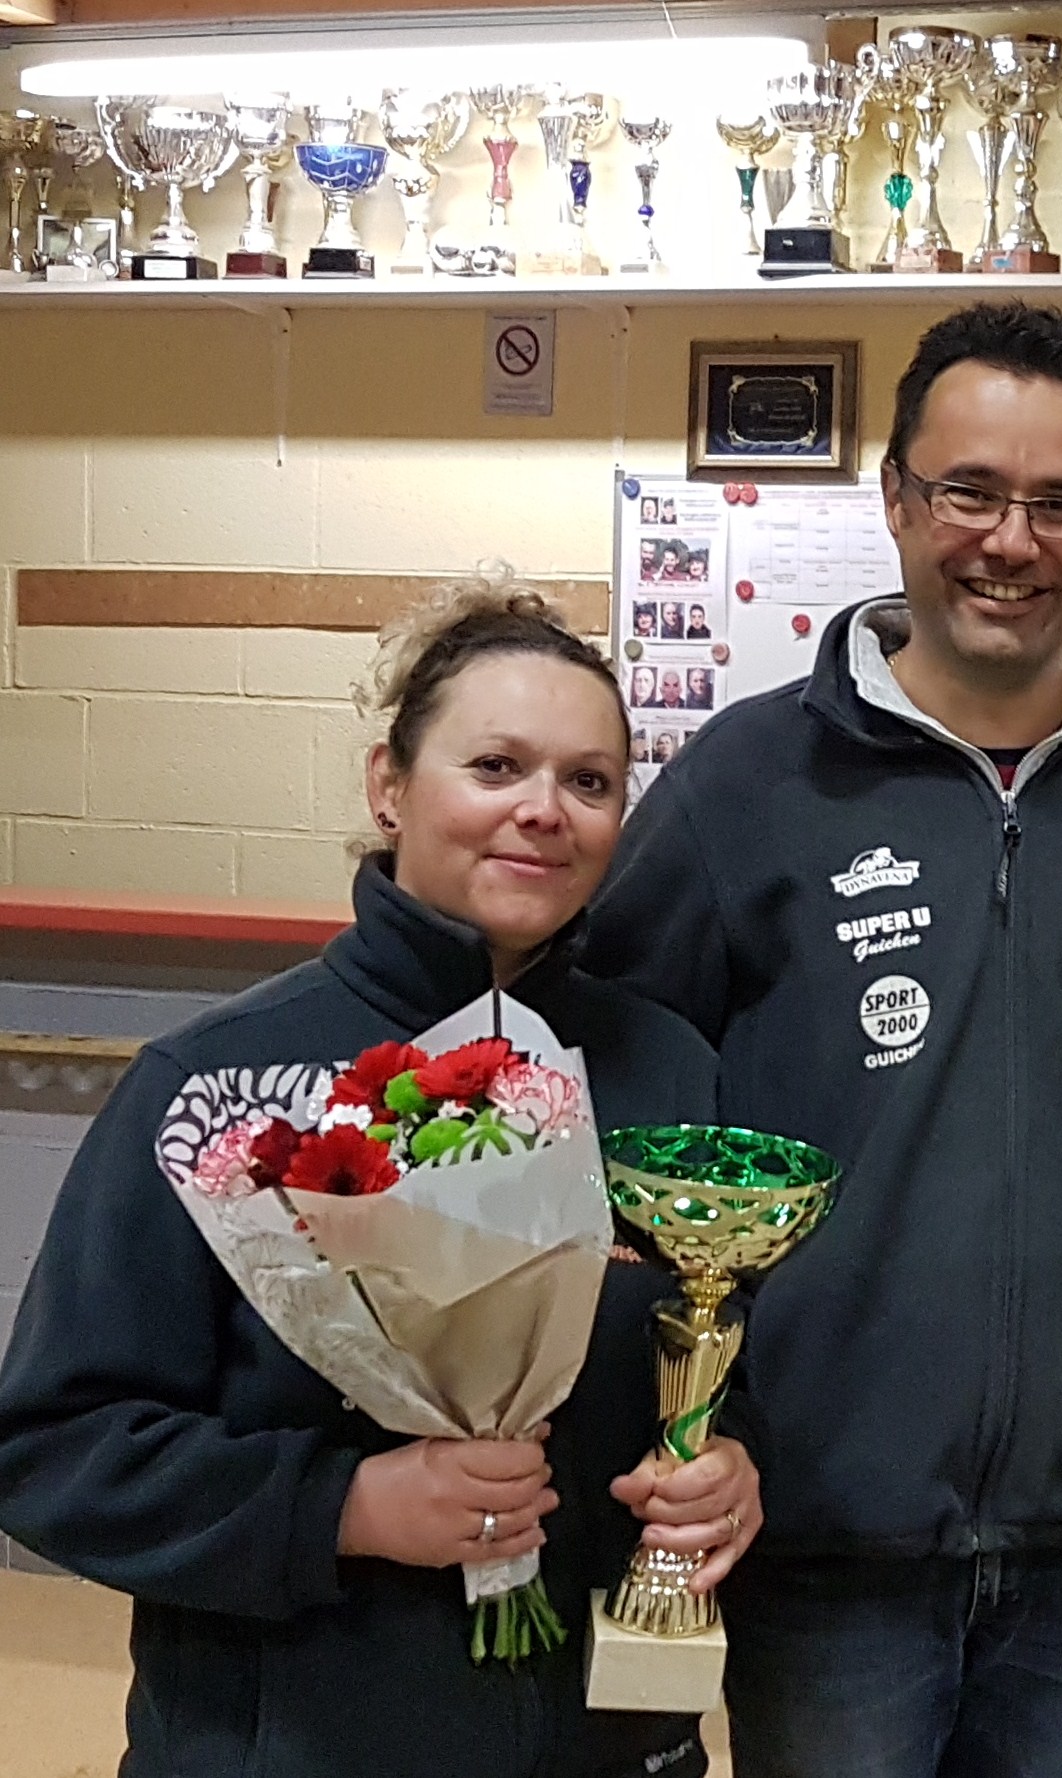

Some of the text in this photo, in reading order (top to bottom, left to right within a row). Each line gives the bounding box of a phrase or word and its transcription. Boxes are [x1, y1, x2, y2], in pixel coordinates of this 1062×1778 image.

[836, 906, 931, 942] SUPER U
[853, 931, 921, 963] Guichen
[865, 987, 919, 1013] SPORT
[877, 1013, 918, 1037] 2000
